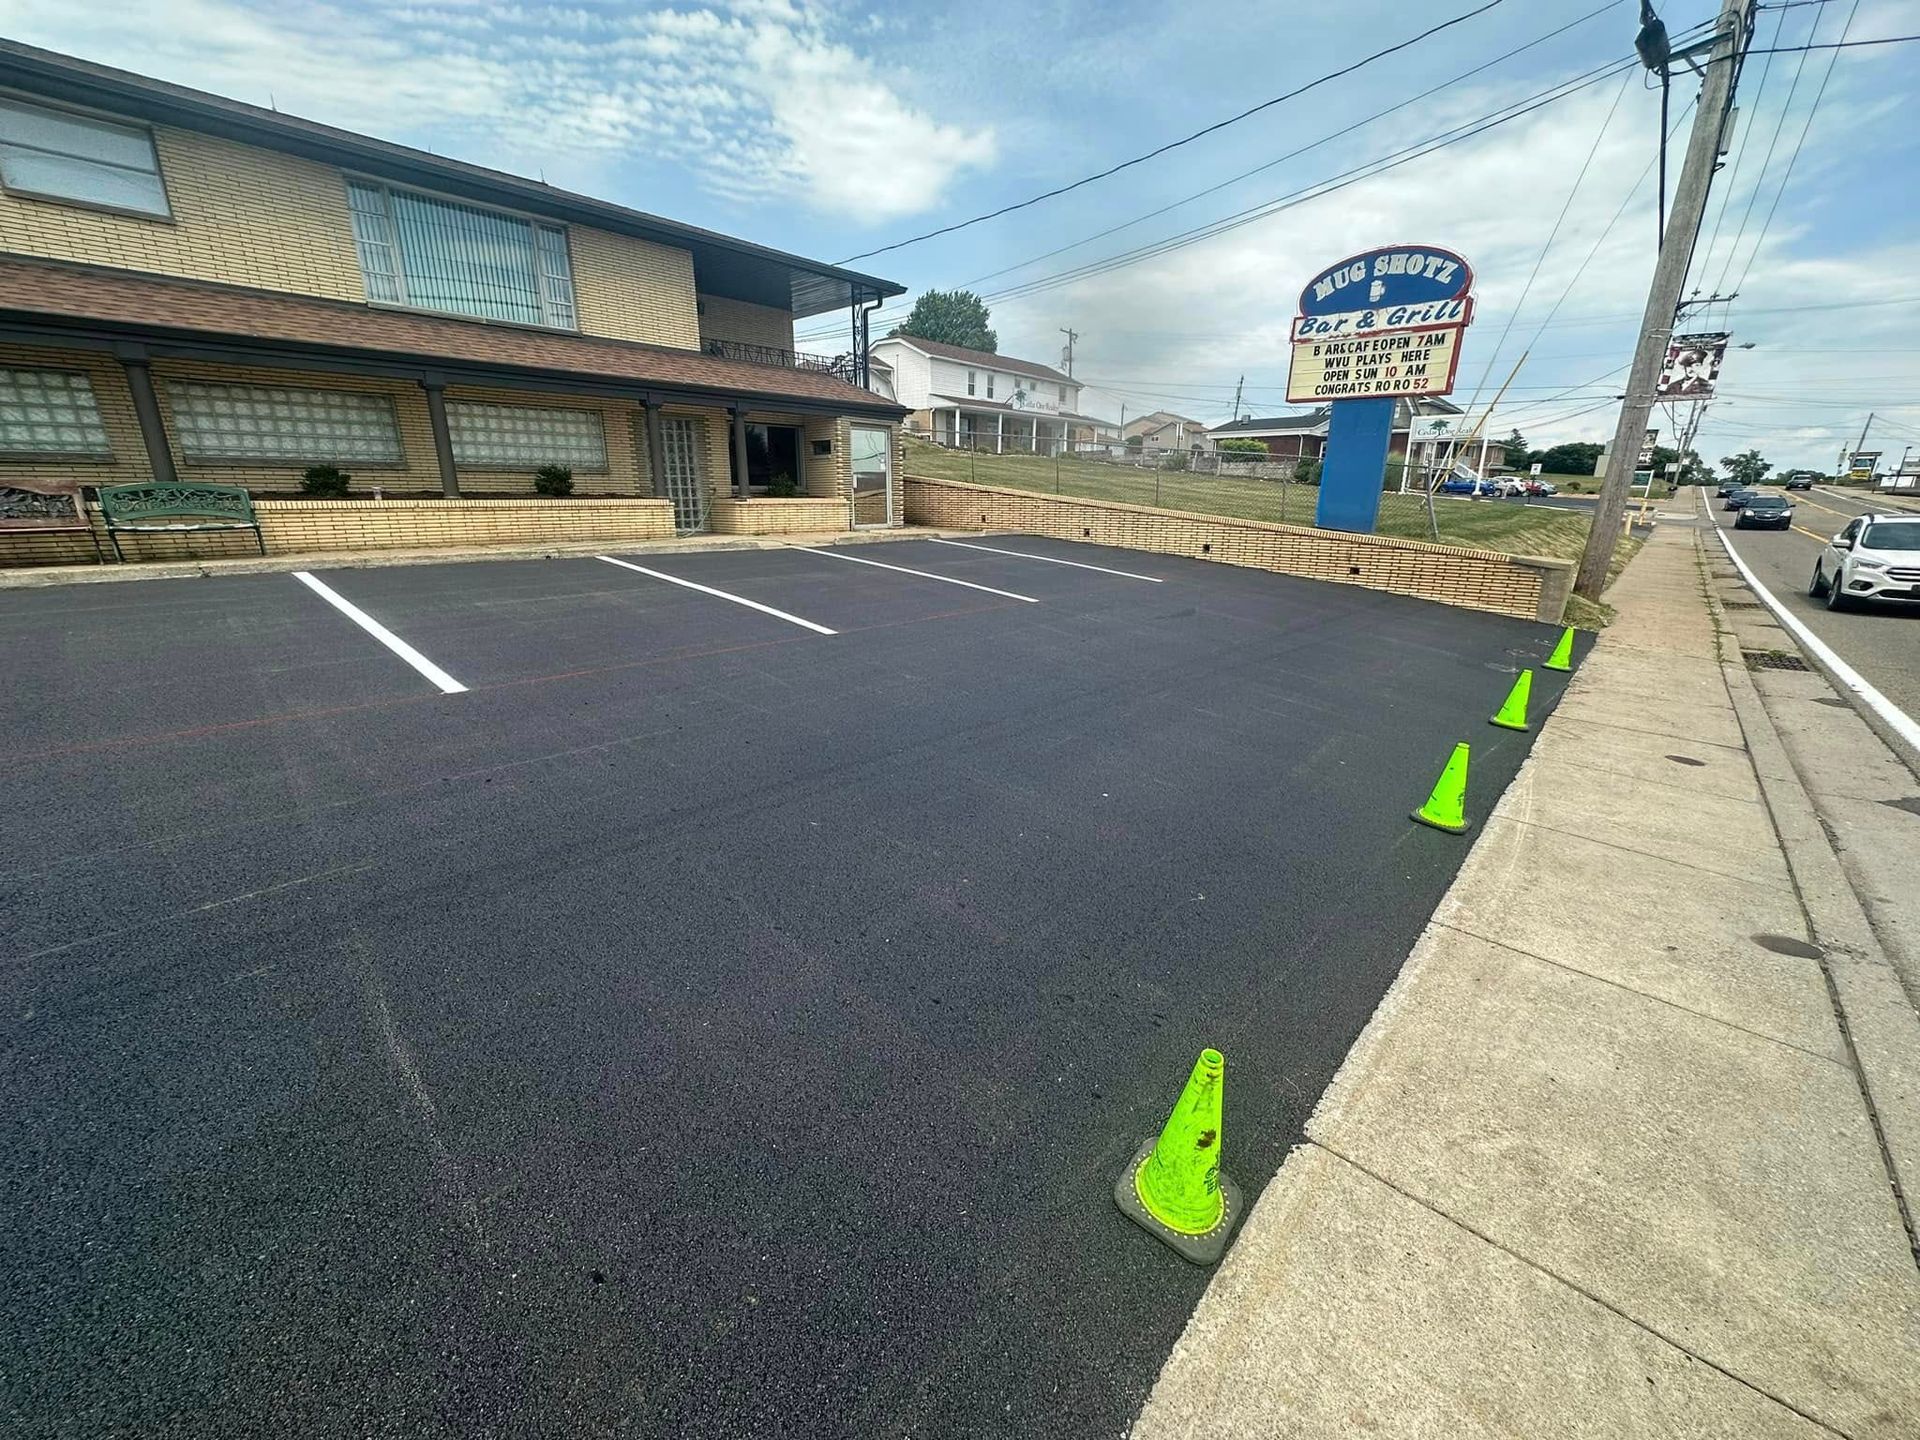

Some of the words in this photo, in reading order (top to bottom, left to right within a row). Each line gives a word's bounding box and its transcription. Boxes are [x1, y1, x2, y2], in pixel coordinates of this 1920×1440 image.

[1312, 261, 1366, 302] MUG
[1373, 253, 1459, 285] SHOTZ
[1298, 317, 1348, 336] Bar
[1355, 311, 1376, 329] &
[1387, 300, 1464, 327] Grill
[1324, 356, 1350, 369] WVU
[1356, 352, 1392, 366] PLAYS
[1400, 349, 1431, 363] HERE
[1323, 369, 1349, 382] OPEN
[1355, 368, 1378, 380] SUN
[1384, 366, 1398, 378] 10
[1405, 364, 1426, 376] AM
[1314, 382, 1371, 396] CONGRATS
[1413, 377, 1429, 389] 52
